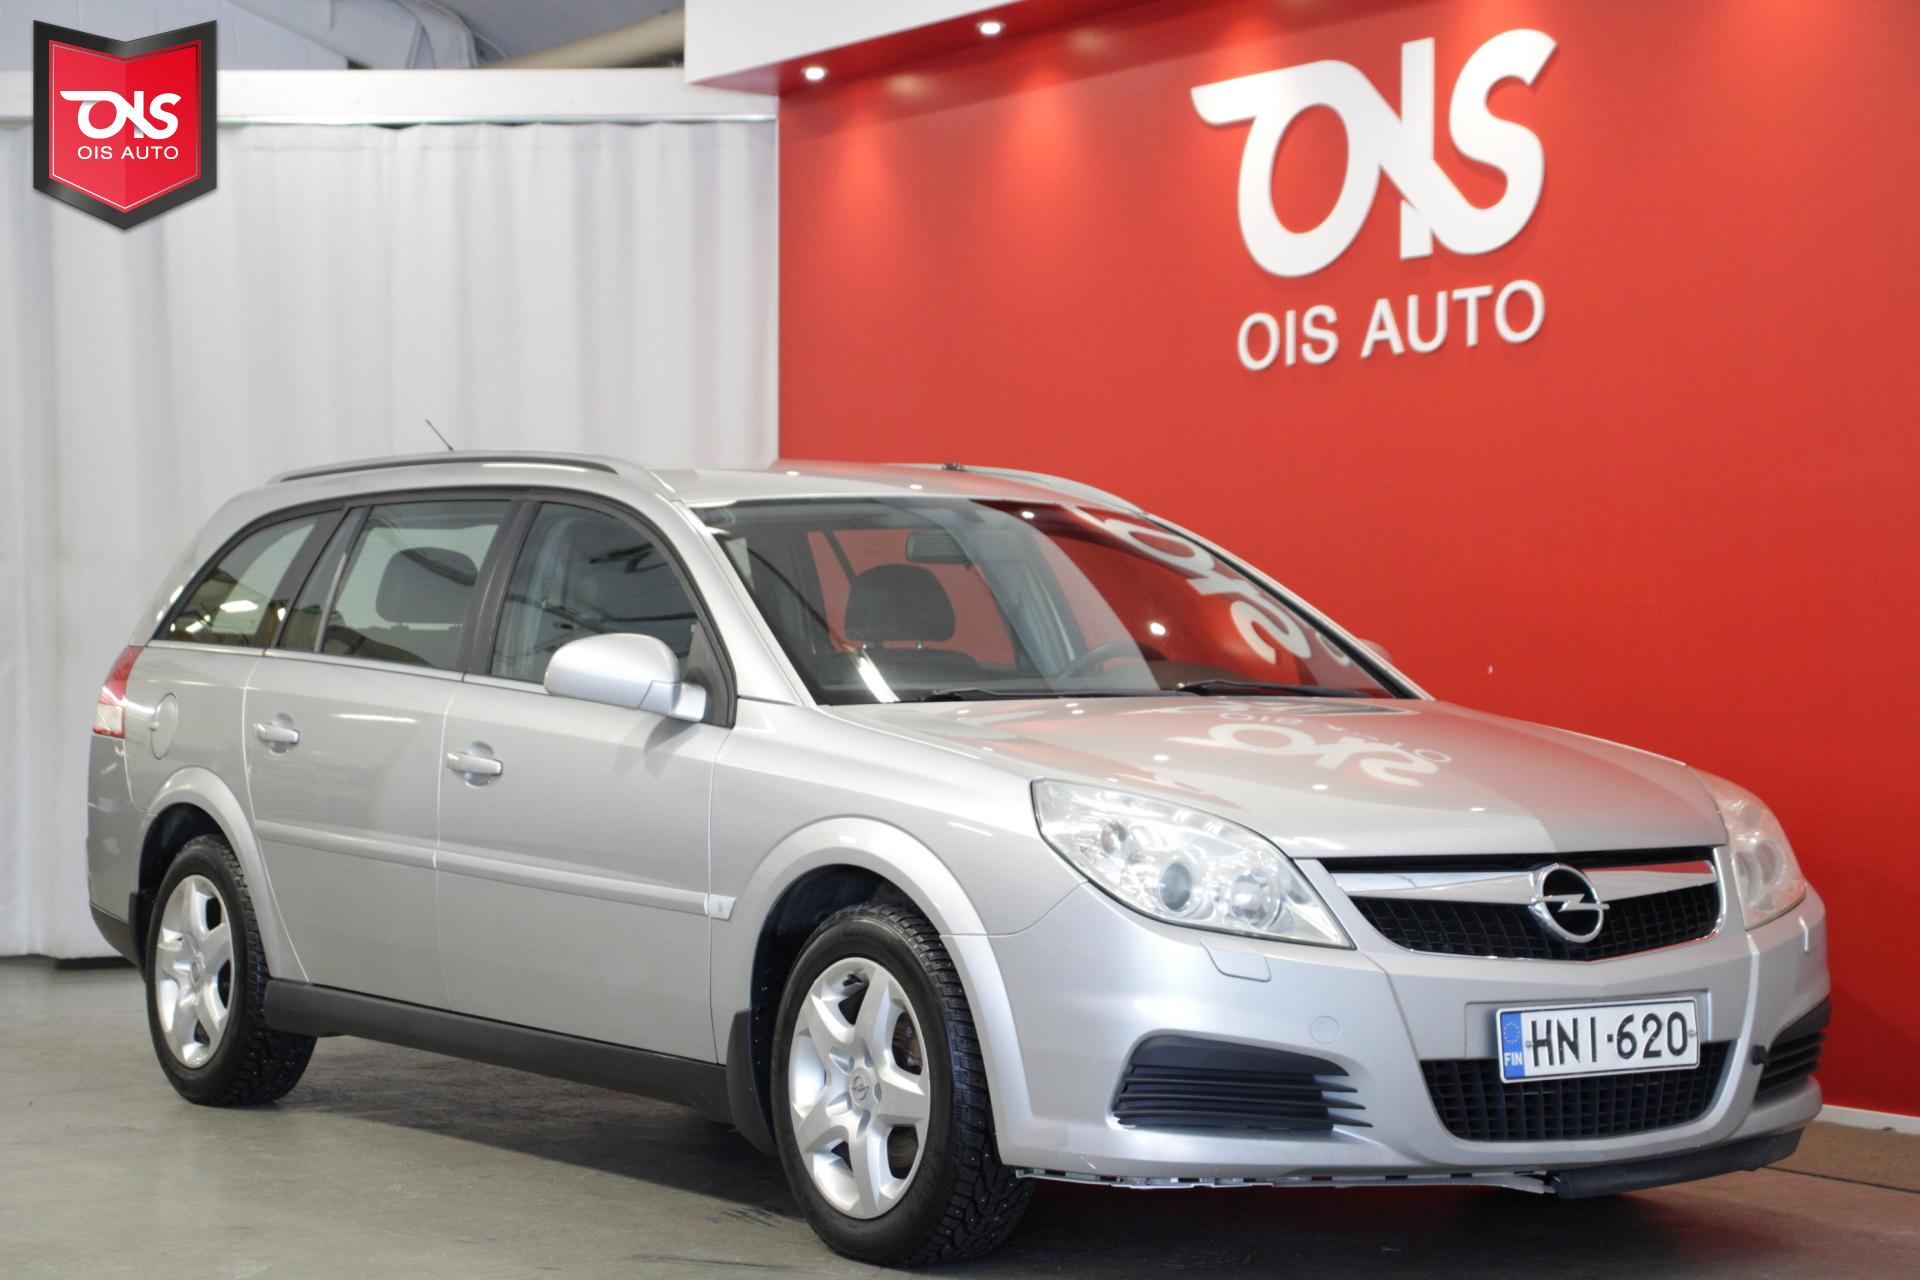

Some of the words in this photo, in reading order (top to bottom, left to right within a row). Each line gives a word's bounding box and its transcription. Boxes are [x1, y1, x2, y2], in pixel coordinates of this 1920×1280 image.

[1191, 28, 1557, 277] OIS
[1237, 304, 1339, 371] OIS
[1360, 279, 1546, 358] AUTO
[1504, 1050, 1523, 1067] FIN
[1531, 1011, 1689, 1067] HNI-620
